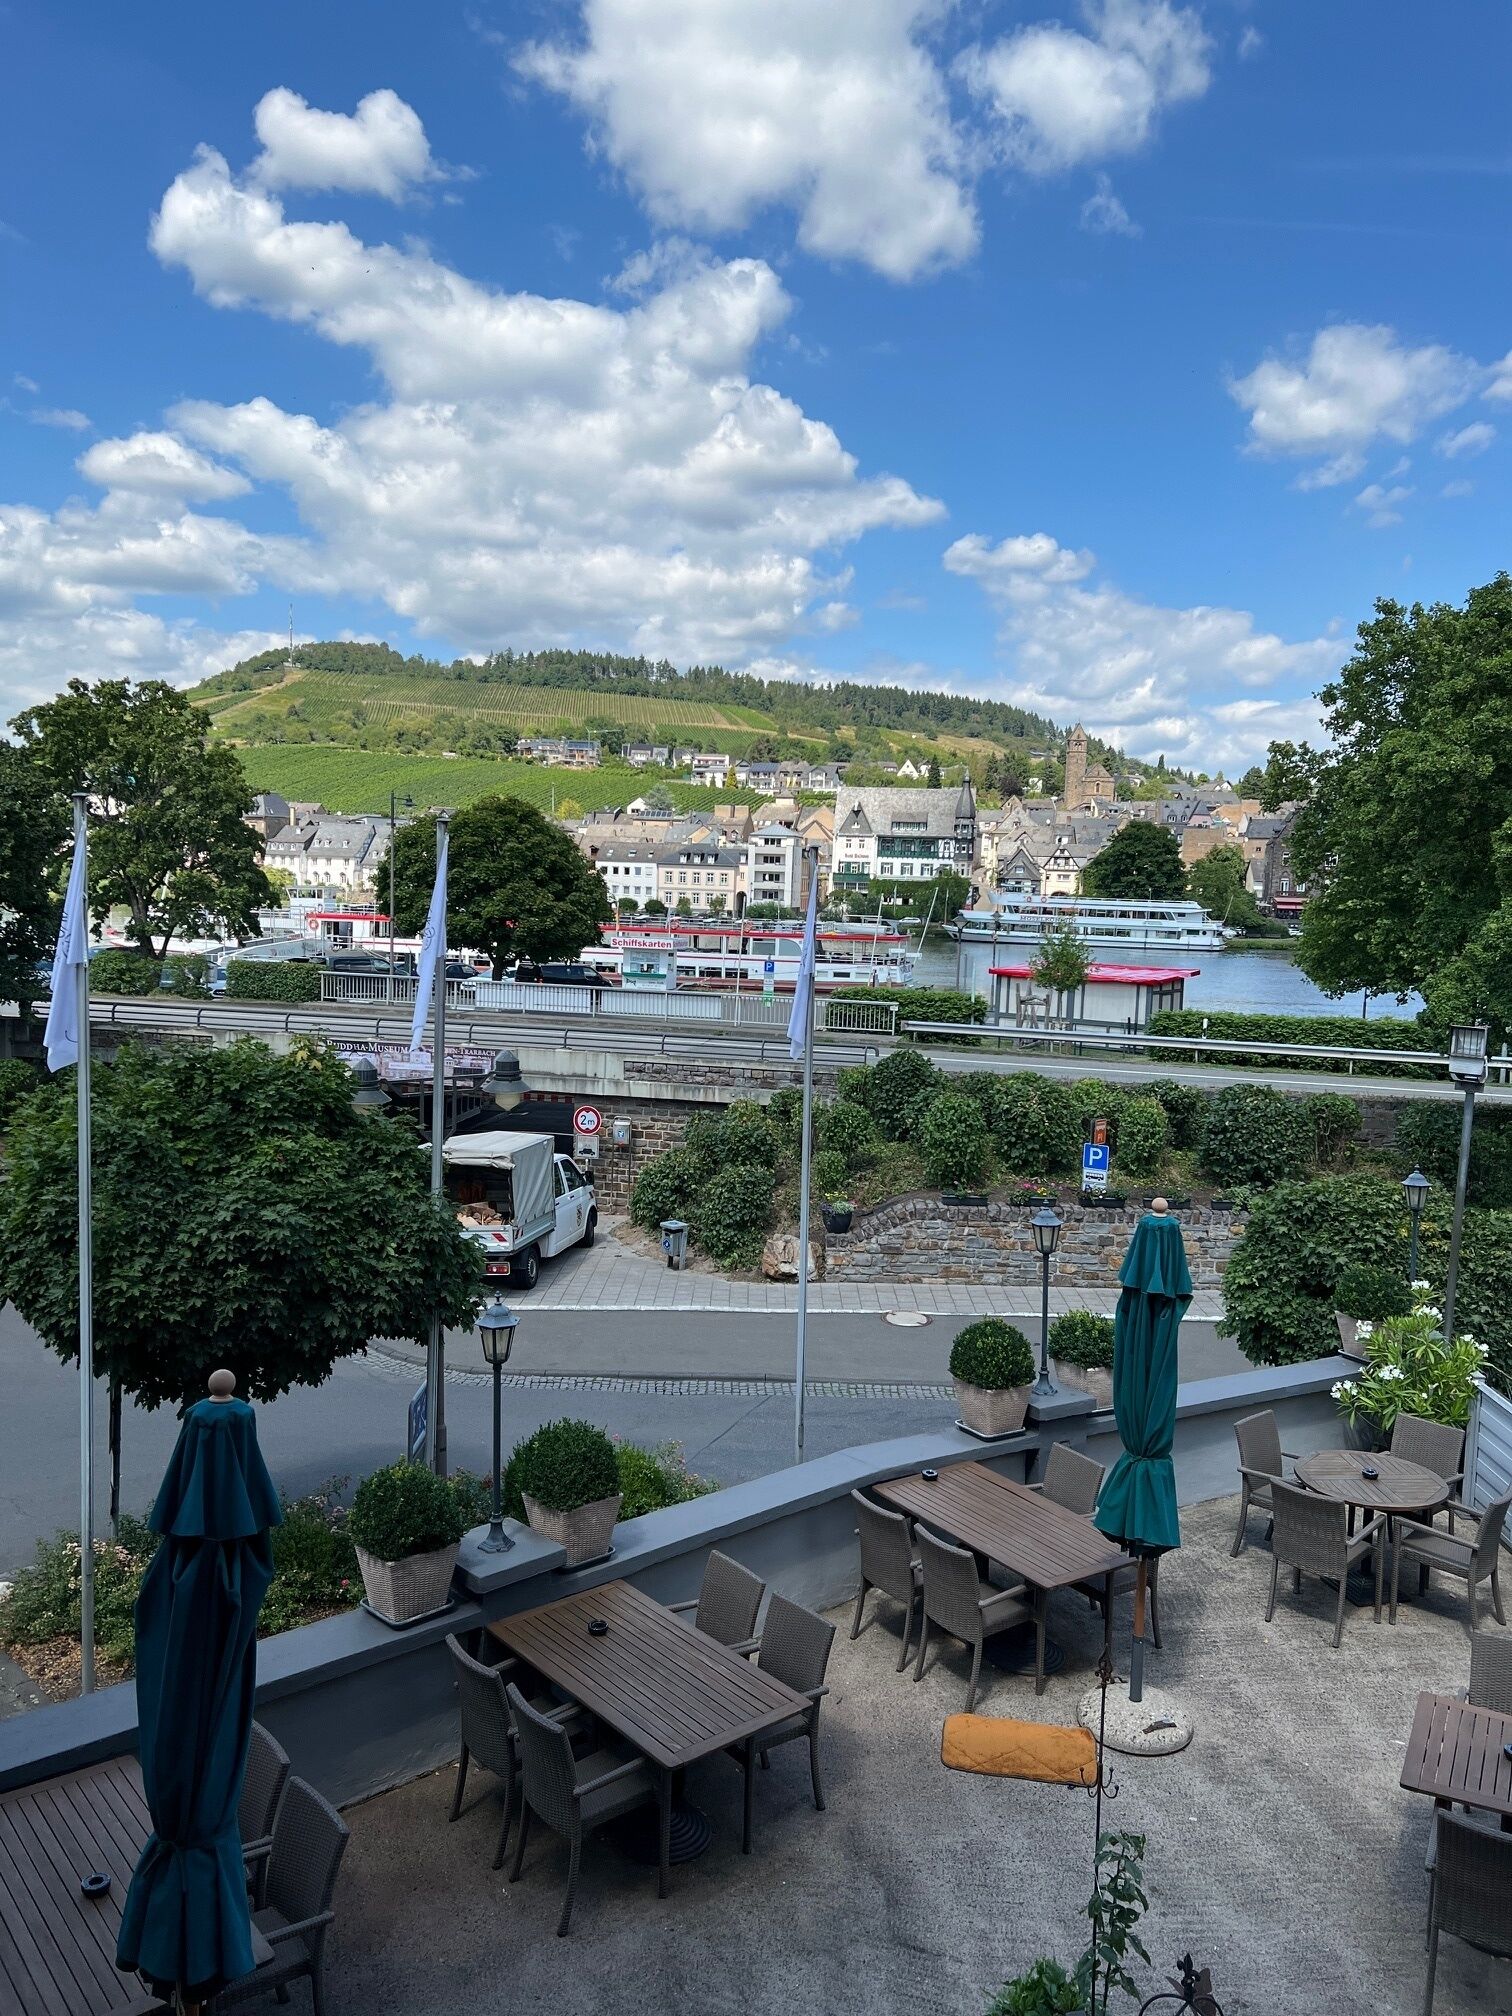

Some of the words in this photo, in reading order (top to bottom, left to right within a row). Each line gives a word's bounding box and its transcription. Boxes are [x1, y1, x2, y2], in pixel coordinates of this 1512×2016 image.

[612, 938, 672, 949] Schiffskarten
[766, 963, 772, 971] P
[1089, 1147, 1103, 1166] P
